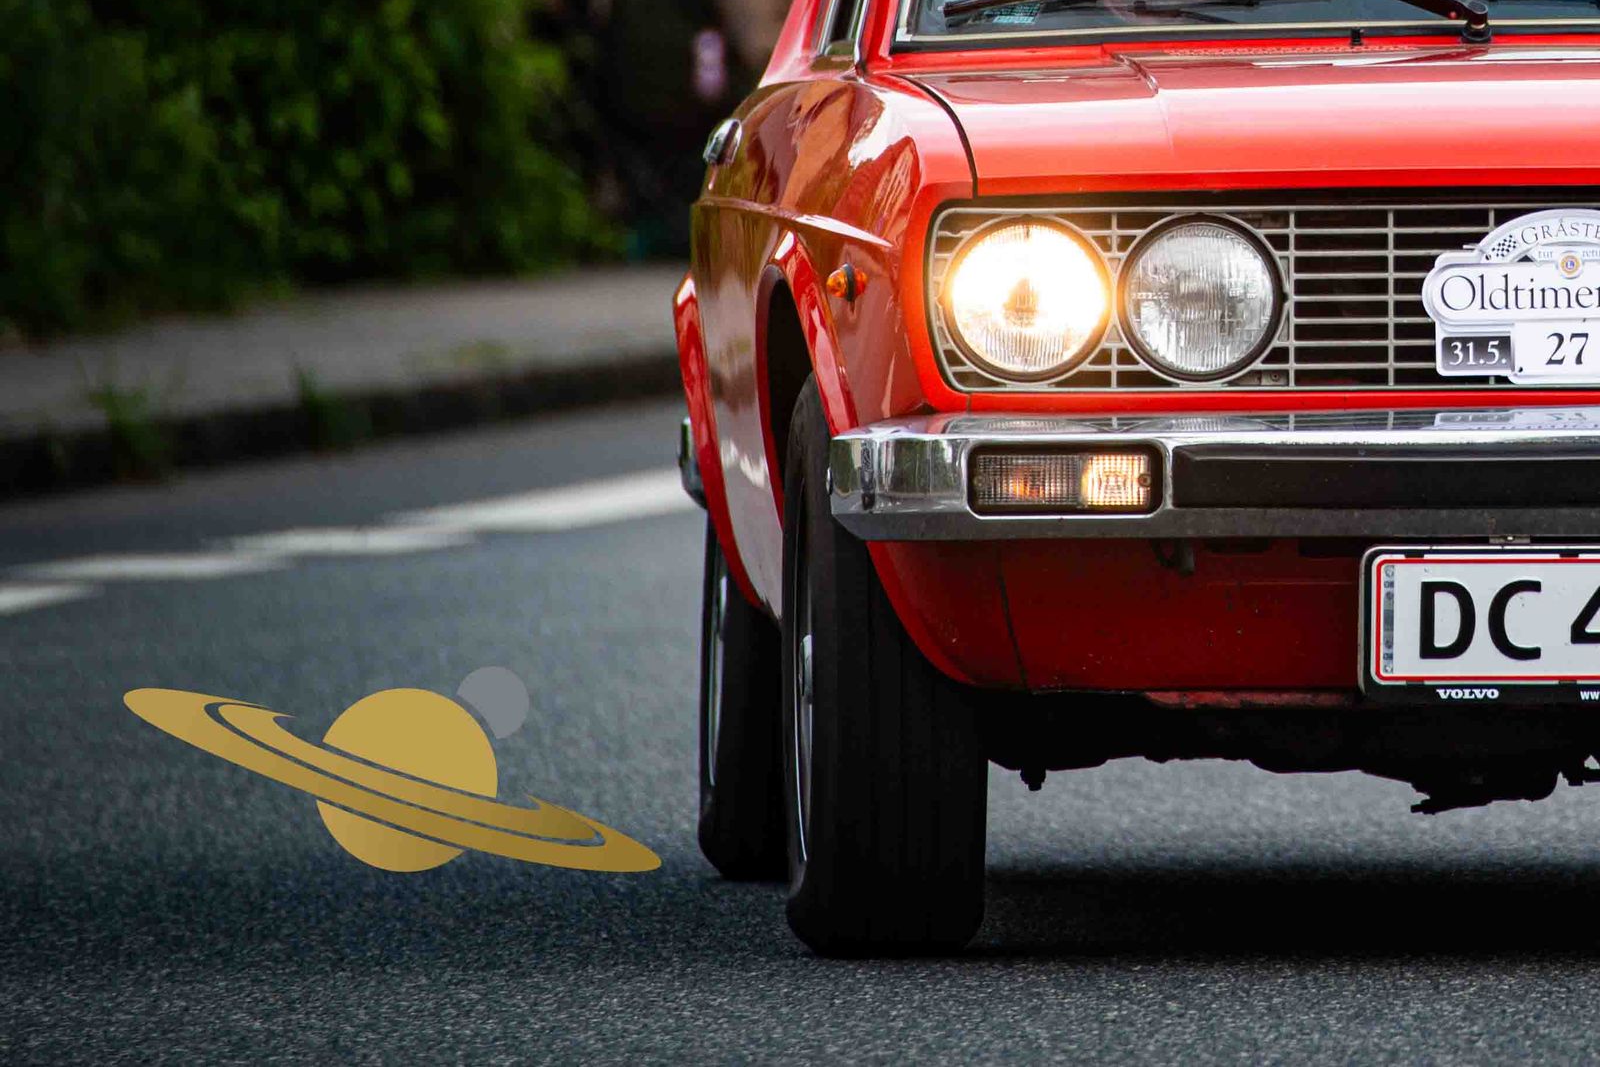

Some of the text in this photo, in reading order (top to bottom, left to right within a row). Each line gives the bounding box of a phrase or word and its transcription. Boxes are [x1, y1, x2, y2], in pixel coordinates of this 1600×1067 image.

[1450, 340, 1507, 366] 31.5.
[1545, 332, 1589, 366] 27
[1419, 580, 1541, 660] DC
[1436, 689, 1499, 700] VOLVO
